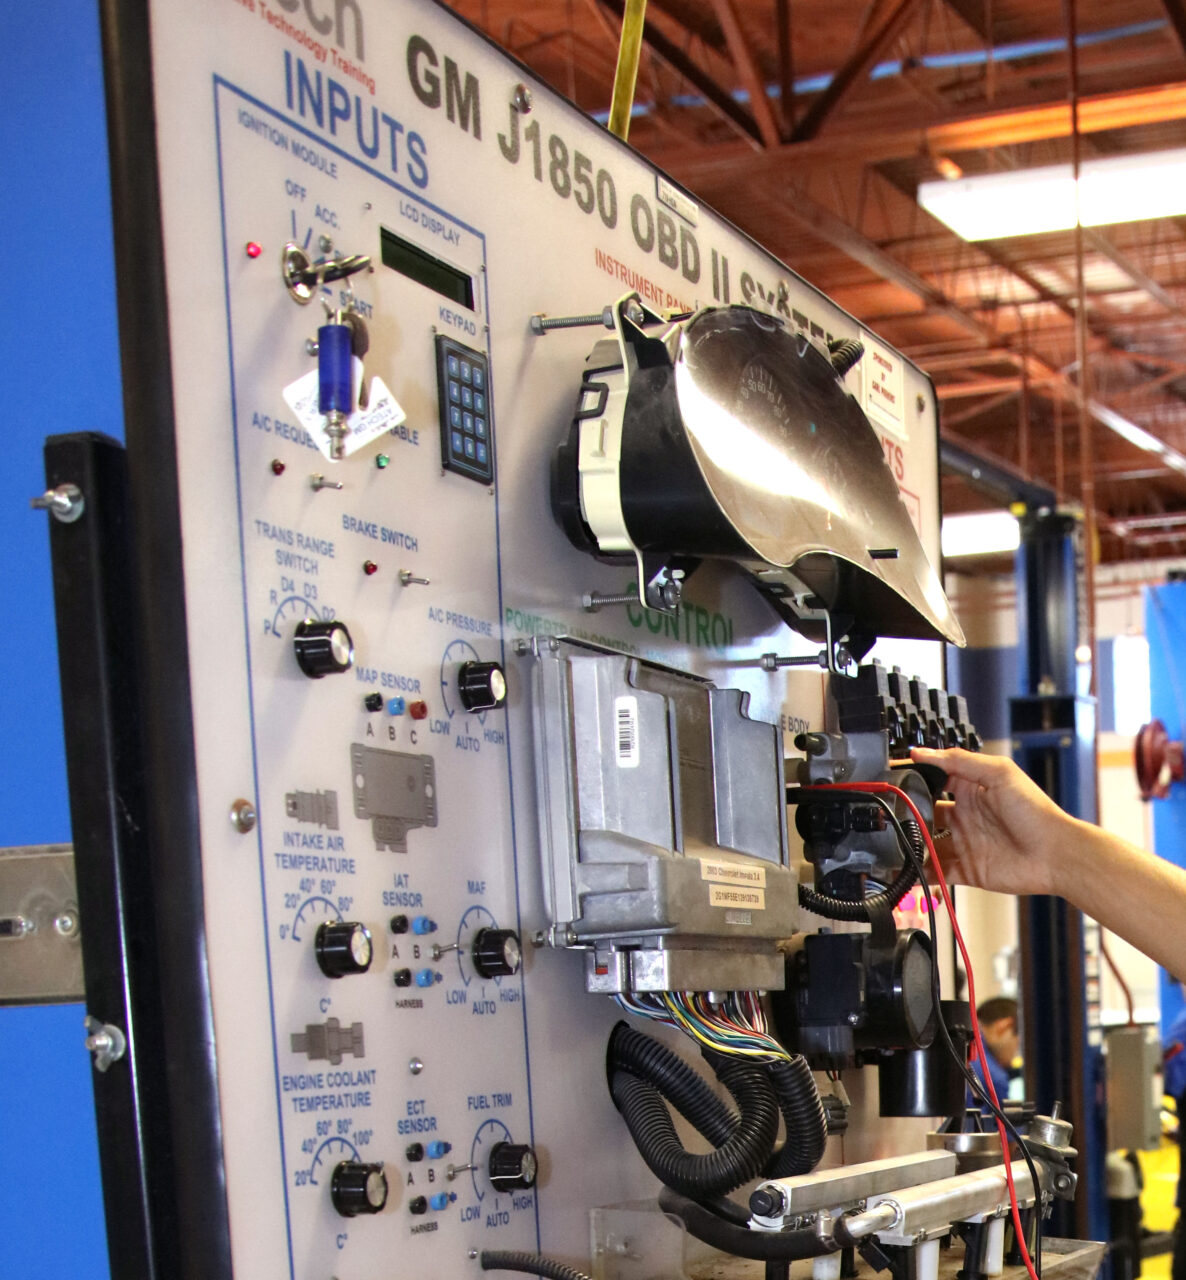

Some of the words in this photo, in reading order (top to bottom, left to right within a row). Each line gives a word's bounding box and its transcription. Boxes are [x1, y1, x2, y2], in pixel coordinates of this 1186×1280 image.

[258, 1, 327, 63] Technology
[330, 48, 375, 95] Training
[284, 50, 430, 190] INPUTS
[238, 108, 289, 151] IGNITION
[290, 138, 339, 180] MODULE
[406, 34, 482, 141] GM
[497, 103, 618, 229] J1850
[630, 193, 701, 285] OBD
[711, 248, 730, 304] II
[285, 179, 306, 201] OFF
[315, 204, 341, 230] ACC.
[399, 201, 419, 223] LCD
[421, 209, 461, 247] DISPLAY
[594, 247, 664, 306] INSTRUMENT
[439, 306, 476, 336] KEYPAD
[252, 411, 273, 432] A/C
[255, 519, 294, 547] TRANS
[297, 533, 335, 558] RANGE
[342, 514, 378, 539] BRAKE
[381, 526, 418, 552] SWITCH
[275, 549, 319, 576] SWITCH
[270, 590, 277, 604] R
[281, 576, 295, 593] D4
[304, 582, 318, 600] D3
[322, 605, 336, 621] D2
[429, 605, 444, 623] A/C
[445, 609, 493, 637] PRESSURE
[264, 618, 271, 634] P
[356, 666, 379, 686] MAP
[381, 671, 421, 694] SENSOR
[367, 722, 374, 737] A
[388, 726, 396, 741] B
[410, 730, 418, 745] C
[430, 718, 450, 736] LOW
[484, 726, 505, 746] HIGH
[788, 717, 811, 735] BODY
[456, 734, 480, 752] AUTO
[283, 831, 324, 850] INTAKE
[327, 836, 345, 852] AIR
[275, 852, 356, 875] TEMPERATURE
[300, 877, 316, 893] 40°
[320, 879, 336, 895] 60°
[394, 873, 410, 889] IAT
[467, 880, 486, 895] MAF
[284, 893, 300, 909] 20°
[337, 896, 353, 912] 80°
[382, 891, 423, 908] SENSOR
[279, 925, 289, 940] 0°
[391, 944, 399, 959] A
[413, 945, 420, 959] B
[319, 998, 331, 1014] C°
[395, 998, 423, 1009] HARNESS
[446, 989, 467, 1005] LOW
[500, 988, 520, 1003] HIGH
[472, 1000, 496, 1015] AUTO
[282, 1073, 324, 1092] ENGINE
[327, 1069, 377, 1088] COOLANT
[291, 1092, 371, 1113] TEMPERATURE
[406, 1099, 426, 1115] ECT
[467, 1095, 490, 1111] FUEL
[491, 1092, 513, 1109] TRIM
[316, 1119, 332, 1136] 60°
[337, 1118, 353, 1134] 80°
[397, 1117, 437, 1135] SENSOR
[302, 1138, 317, 1154] 40°
[352, 1130, 373, 1146] 100°
[294, 1170, 311, 1187] 20°
[407, 1171, 414, 1186] A
[428, 1168, 435, 1183] B
[460, 1205, 481, 1222] LOW
[512, 1195, 533, 1211] HIGH
[410, 1221, 438, 1235] HARNESS
[486, 1211, 510, 1228] AUTO
[336, 1233, 347, 1249] C°
